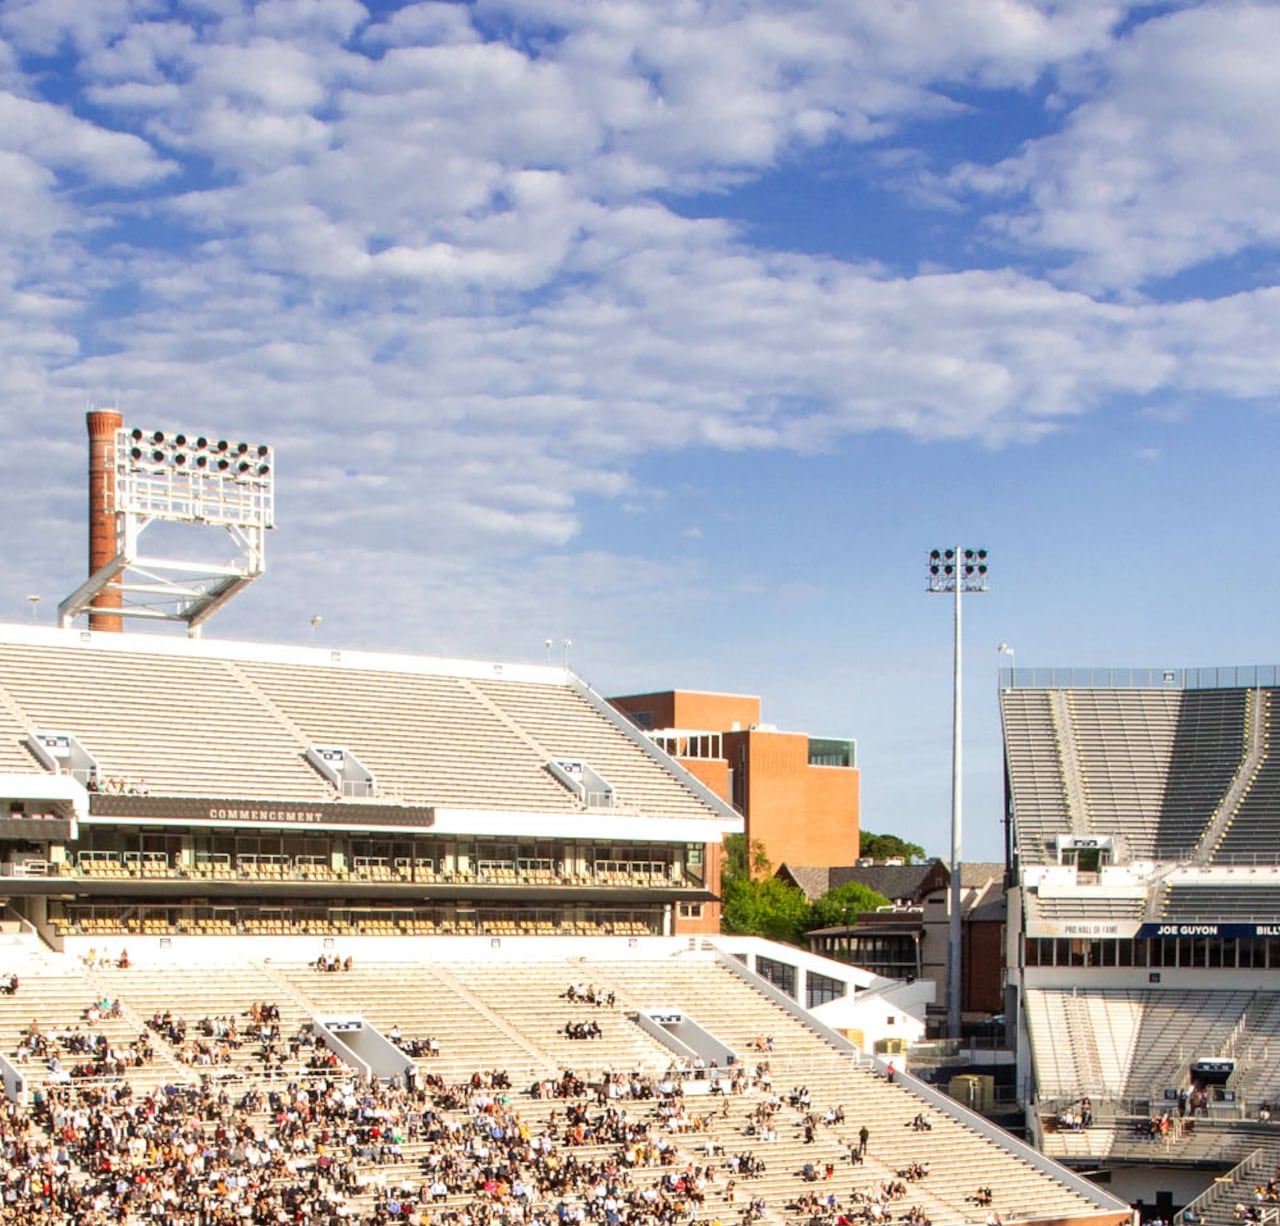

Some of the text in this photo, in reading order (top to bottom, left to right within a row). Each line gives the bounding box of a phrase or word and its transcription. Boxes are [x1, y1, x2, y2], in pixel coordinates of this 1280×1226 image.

[210, 808, 323, 822] COMMENCEMENT
[1064, 926, 1077, 934] PRO
[1078, 926, 1092, 934] HALL
[1093, 926, 1101, 934] OF
[1102, 926, 1118, 934] FAME
[1157, 926, 1218, 935] JOE GUYON
